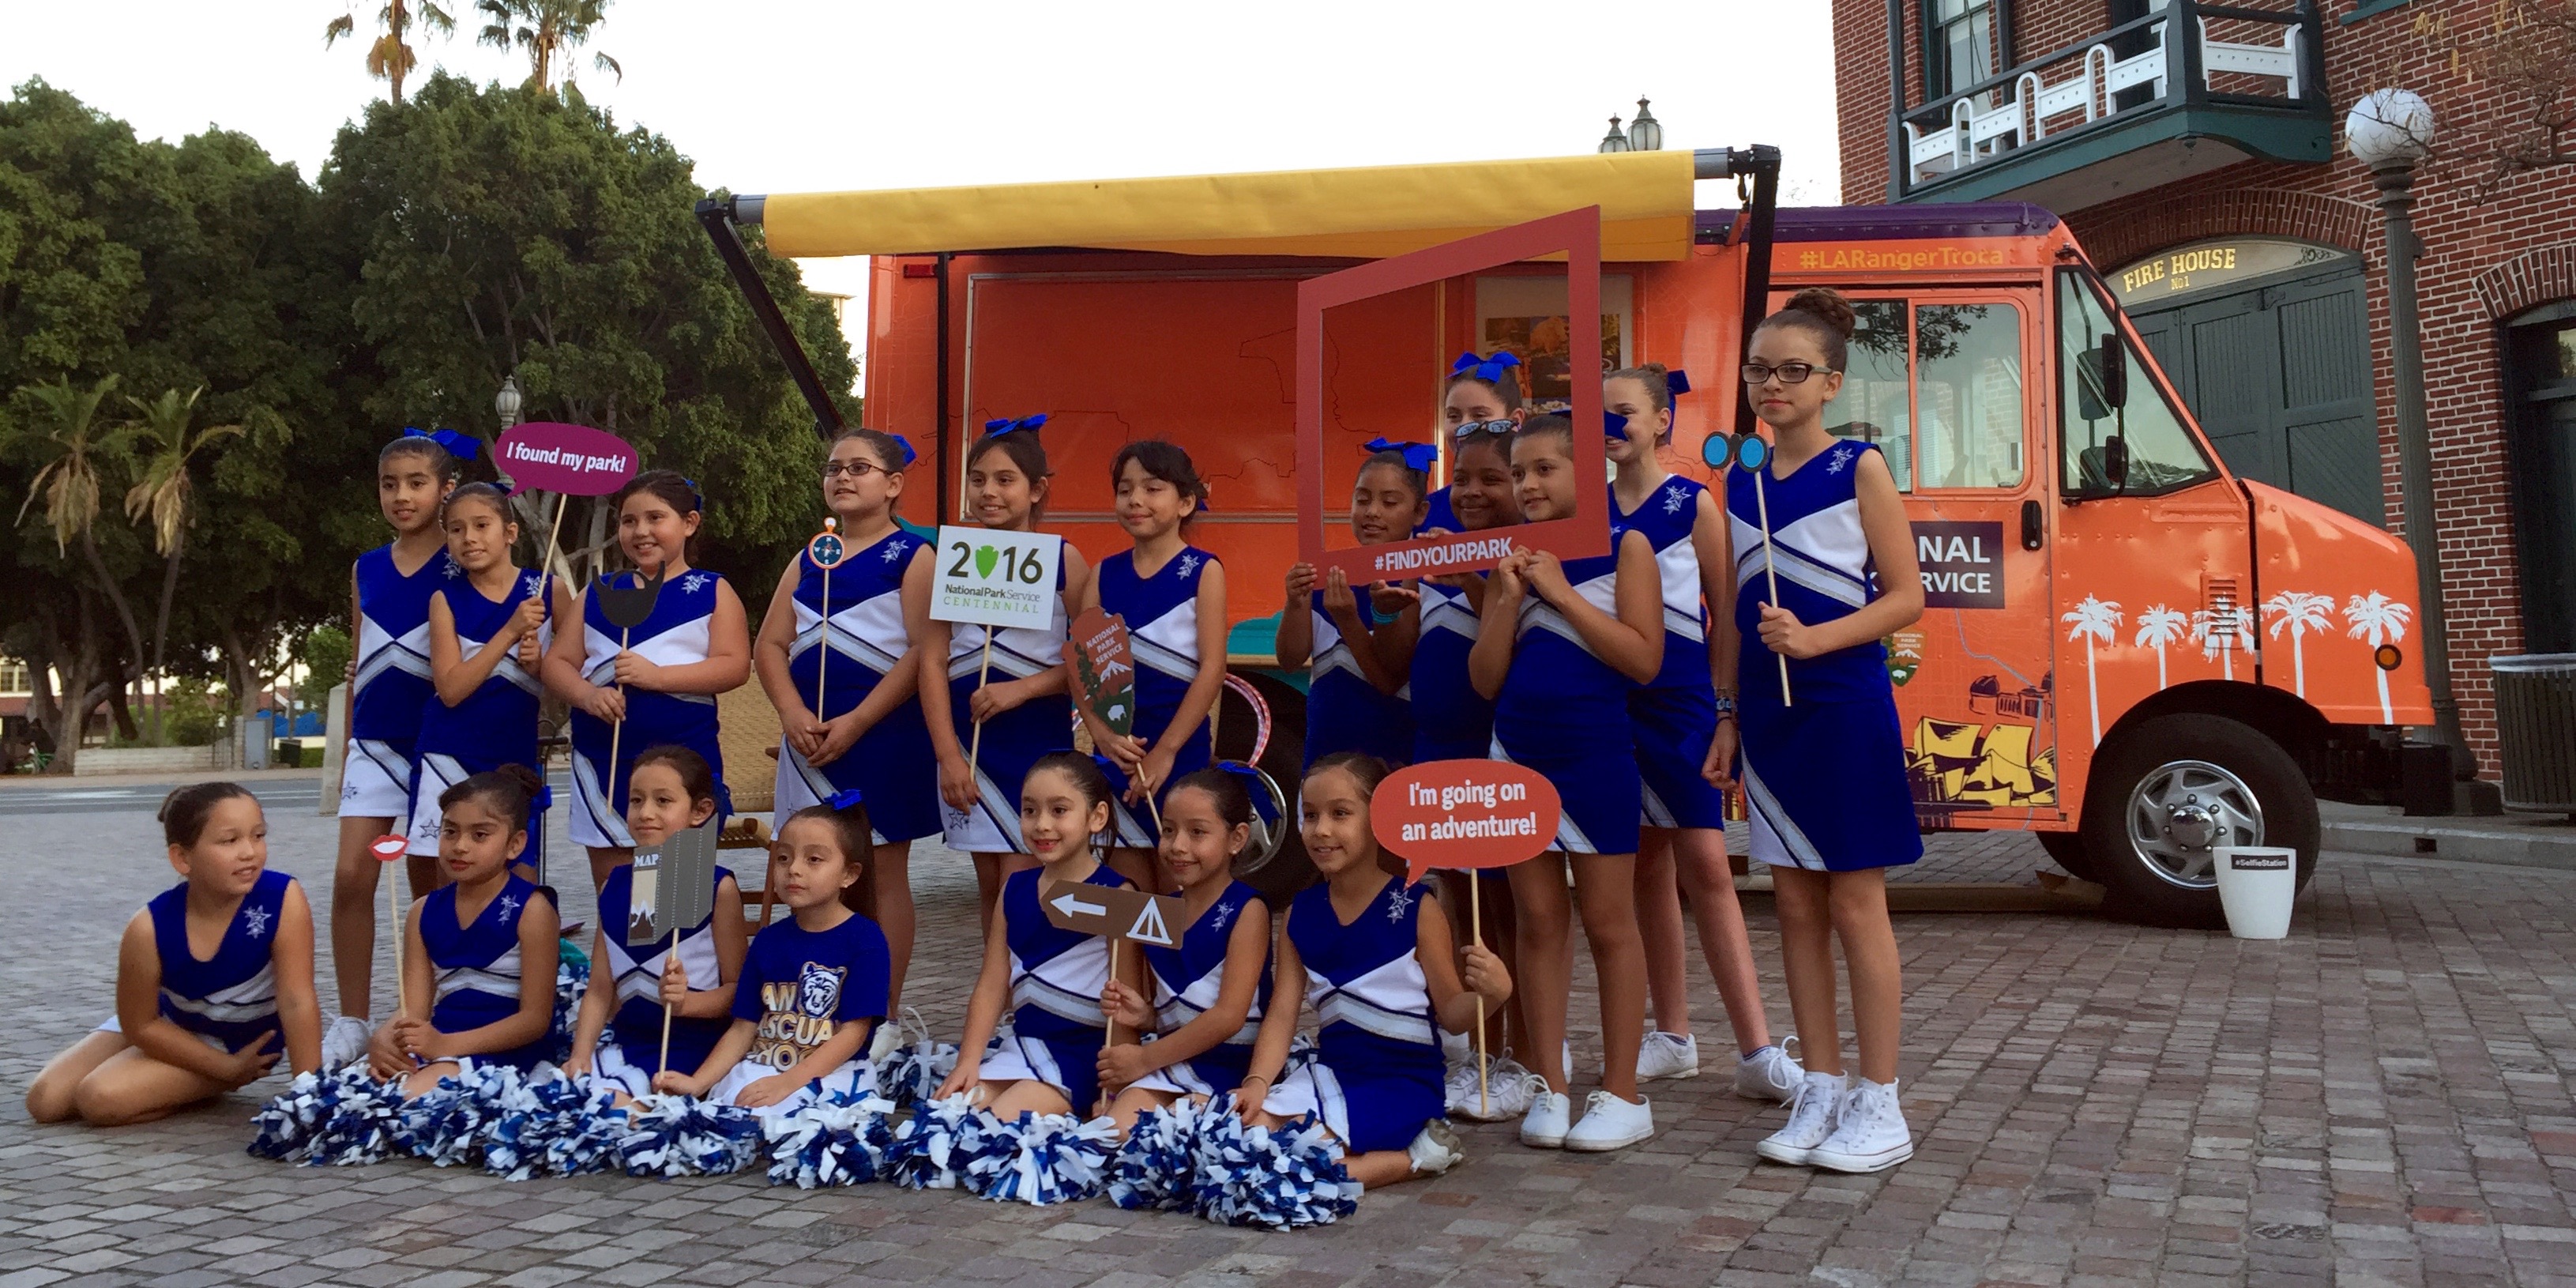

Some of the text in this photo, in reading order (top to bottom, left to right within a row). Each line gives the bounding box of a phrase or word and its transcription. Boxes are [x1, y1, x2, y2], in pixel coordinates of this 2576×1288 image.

[1799, 247, 2003, 271] #LARangerTroca
[2123, 248, 2236, 293] FIRE HOUSE
[506, 442, 626, 473] I found my park!
[1374, 536, 1513, 571] #FINDYOURPARK
[945, 584, 1040, 602] National Park Service
[1920, 571, 1991, 593] RVICE
[943, 596, 1039, 614] CENTENNIAL
[1085, 623, 1121, 649] NATIONAL
[1096, 637, 1115, 653] PARK
[1095, 642, 1124, 665] SERVICE
[1409, 779, 1526, 811] I'm going on
[1402, 812, 1537, 842] an adventure!
[634, 853, 660, 868] MAP
